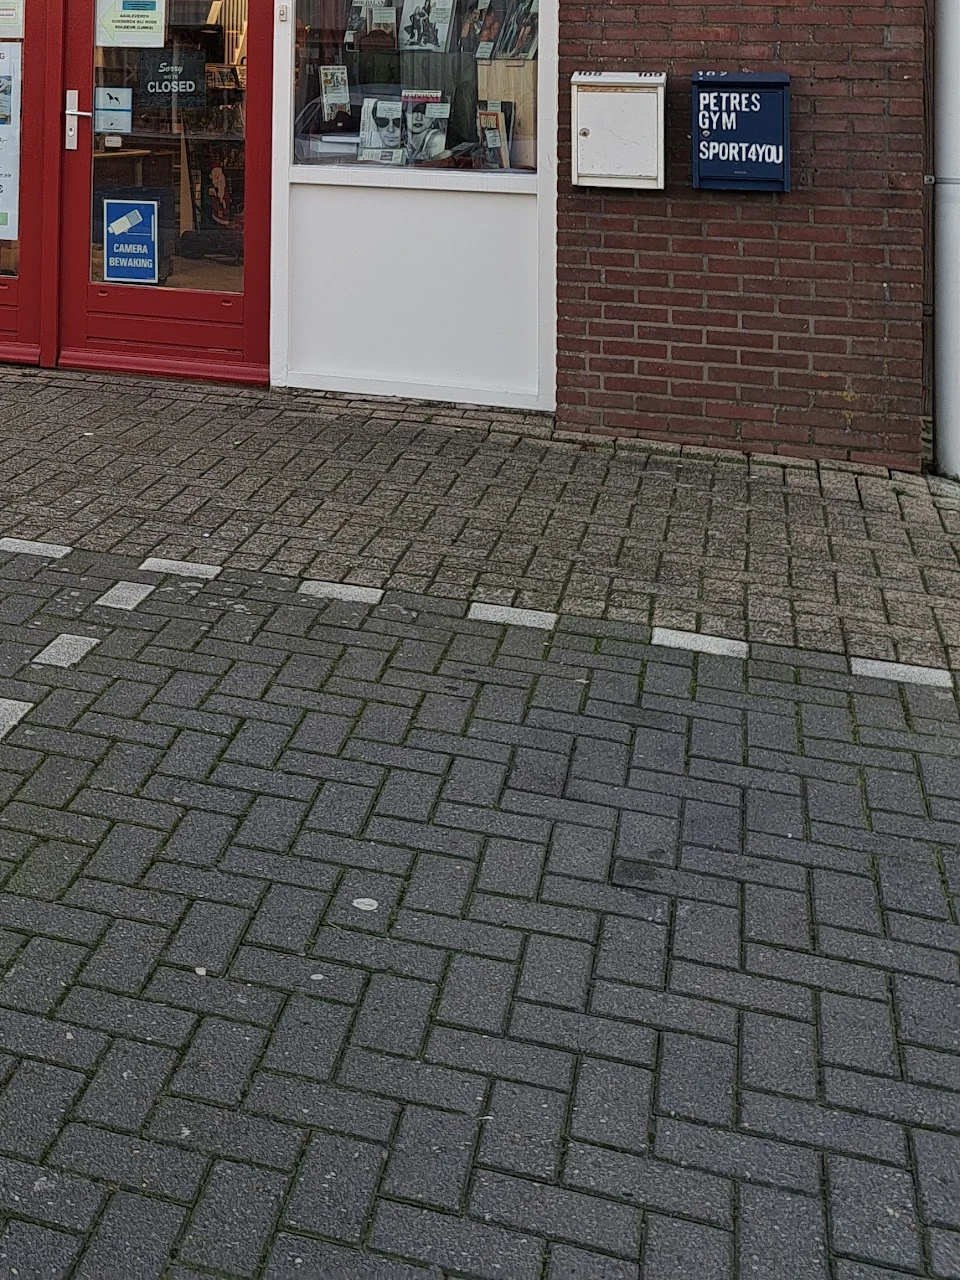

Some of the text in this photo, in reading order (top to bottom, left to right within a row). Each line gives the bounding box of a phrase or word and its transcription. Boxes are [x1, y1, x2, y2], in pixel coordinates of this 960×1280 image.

[158, 62, 183, 74] Sorry
[147, 81, 195, 93] CLOSED
[699, 92, 761, 112] PETRES
[698, 110, 737, 131] GYM
[699, 141, 784, 164] SPORT4YOU
[113, 243, 148, 254] CAMERA
[109, 257, 153, 268] BEWAKING
